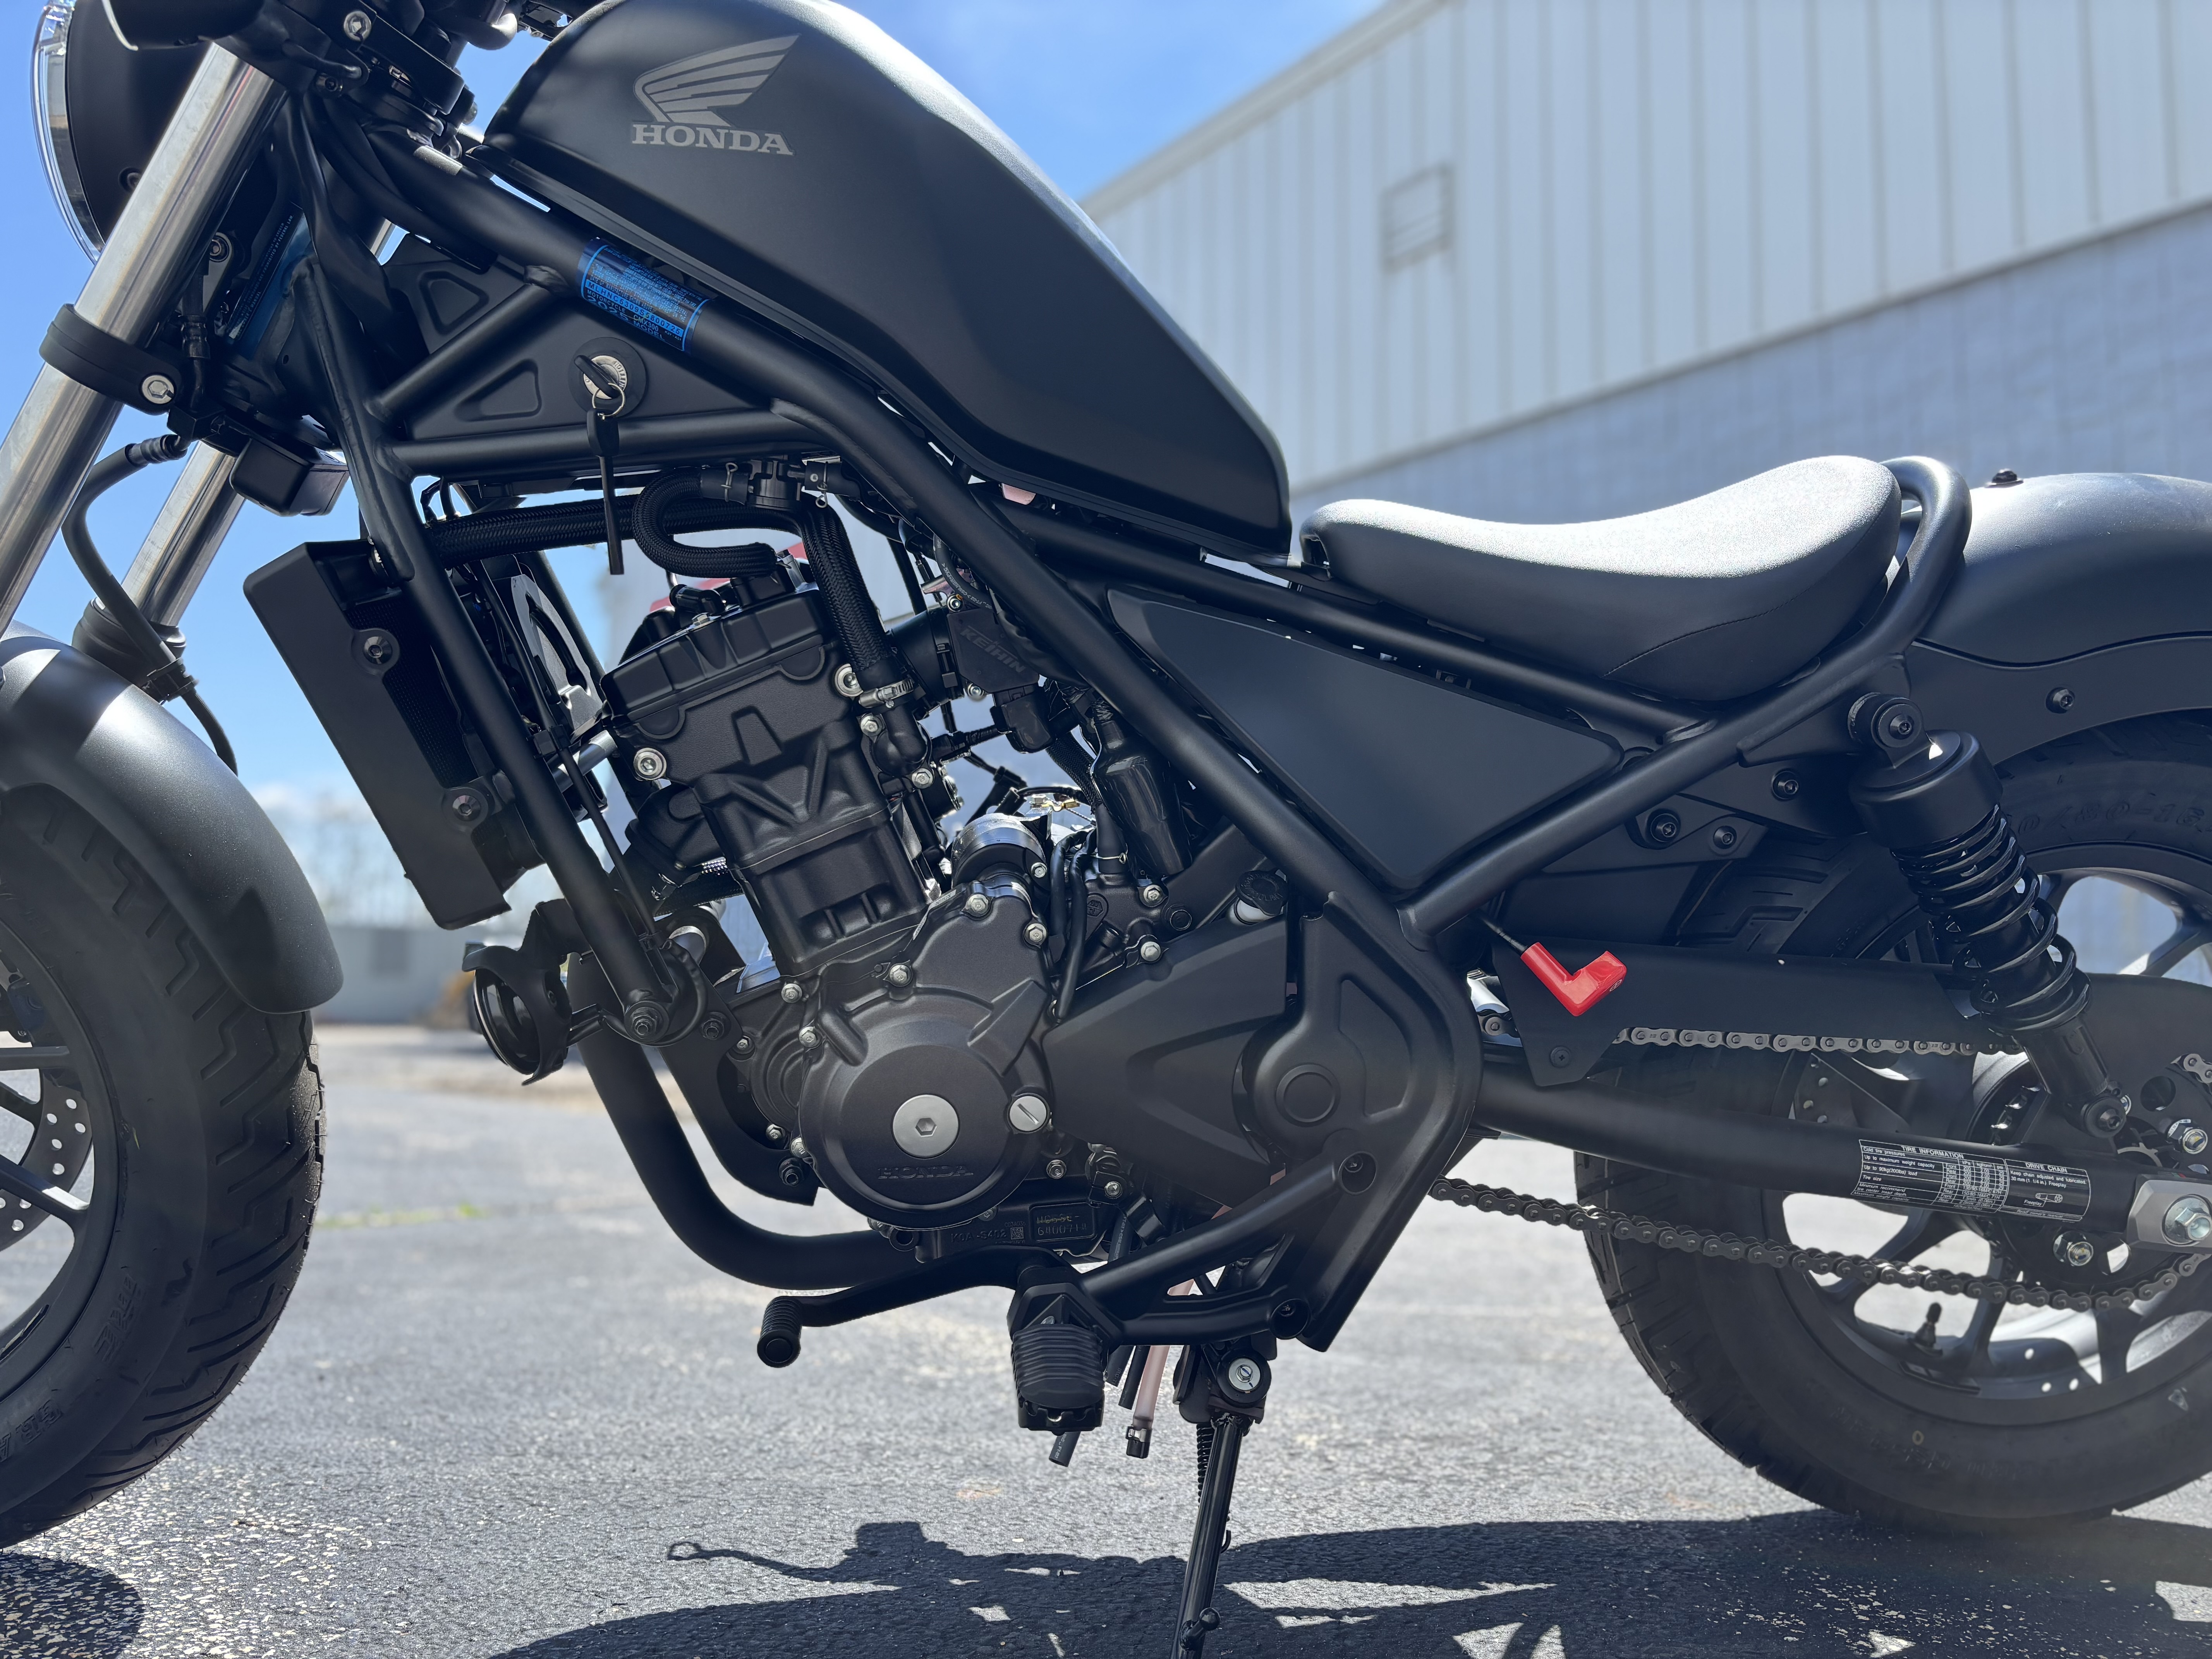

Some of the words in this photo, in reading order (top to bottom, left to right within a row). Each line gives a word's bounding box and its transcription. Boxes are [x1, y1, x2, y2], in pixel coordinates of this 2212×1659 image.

[632, 124, 793, 156] HONDA
[586, 289, 626, 313] MOTORCYCLE
[632, 314, 659, 332] CMX300
[586, 295, 630, 321] 2025
[632, 320, 666, 341] MODEL
[960, 626, 1025, 672] KEIHIN
[1918, 1148, 1964, 1159] INFORMATION
[878, 1165, 974, 1179] HONDA
[1879, 1167, 1906, 1175] 90kg(200lbs)
